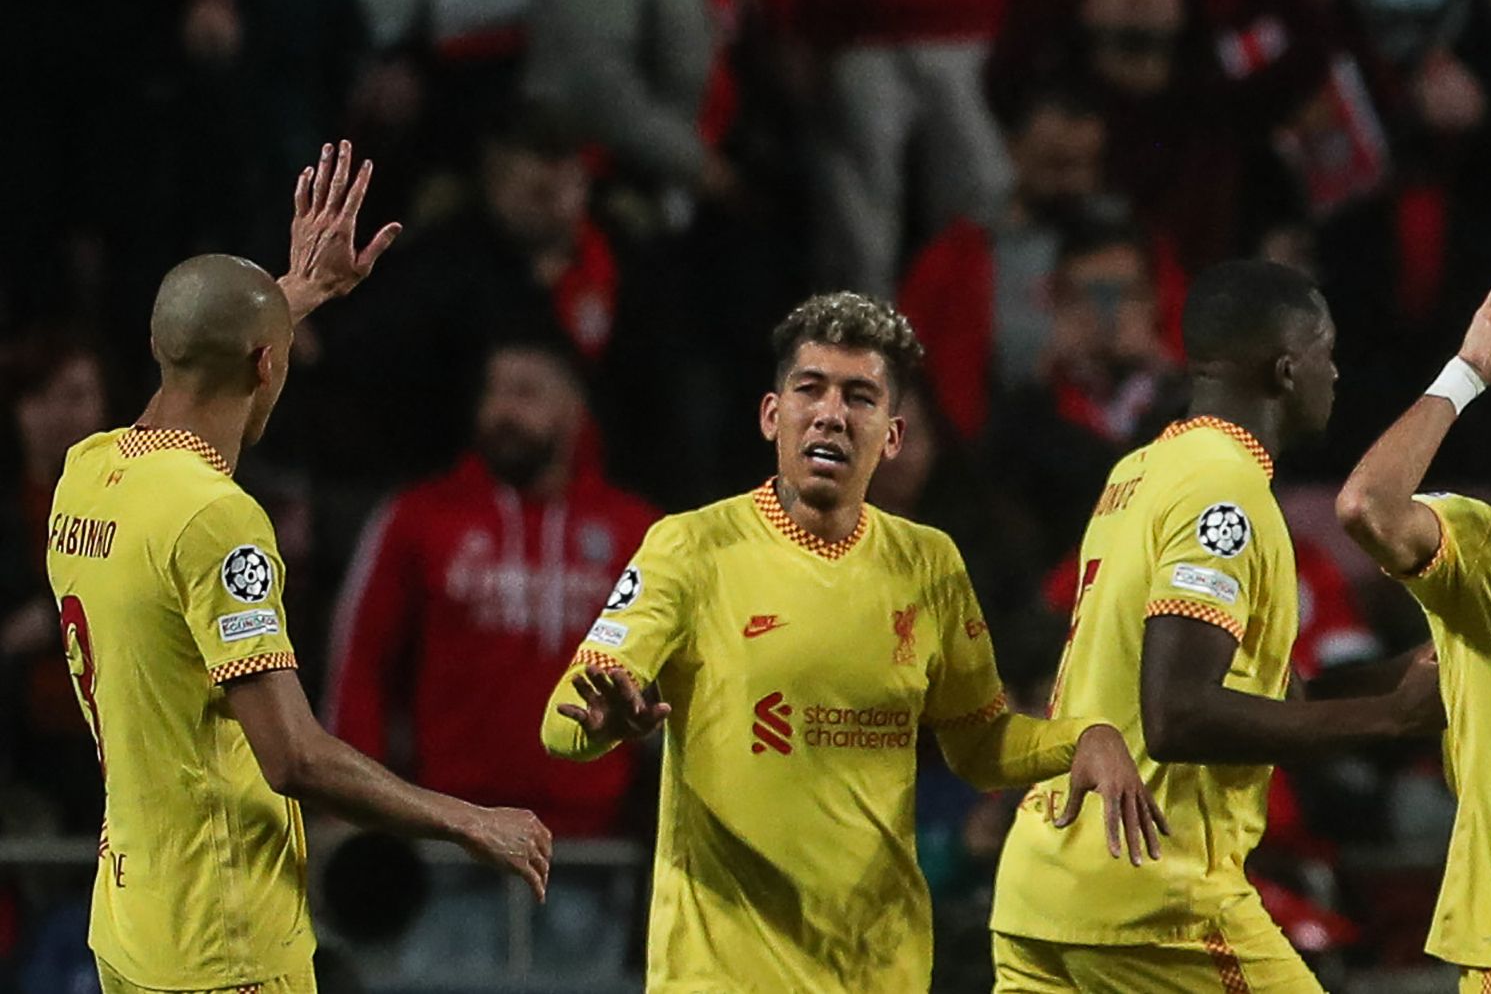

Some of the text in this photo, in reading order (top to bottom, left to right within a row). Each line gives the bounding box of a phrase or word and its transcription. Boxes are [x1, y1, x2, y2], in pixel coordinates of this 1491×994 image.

[48, 512, 116, 559] FABINHO
[804, 704, 910, 726] standard
[804, 727, 912, 749] chartered
